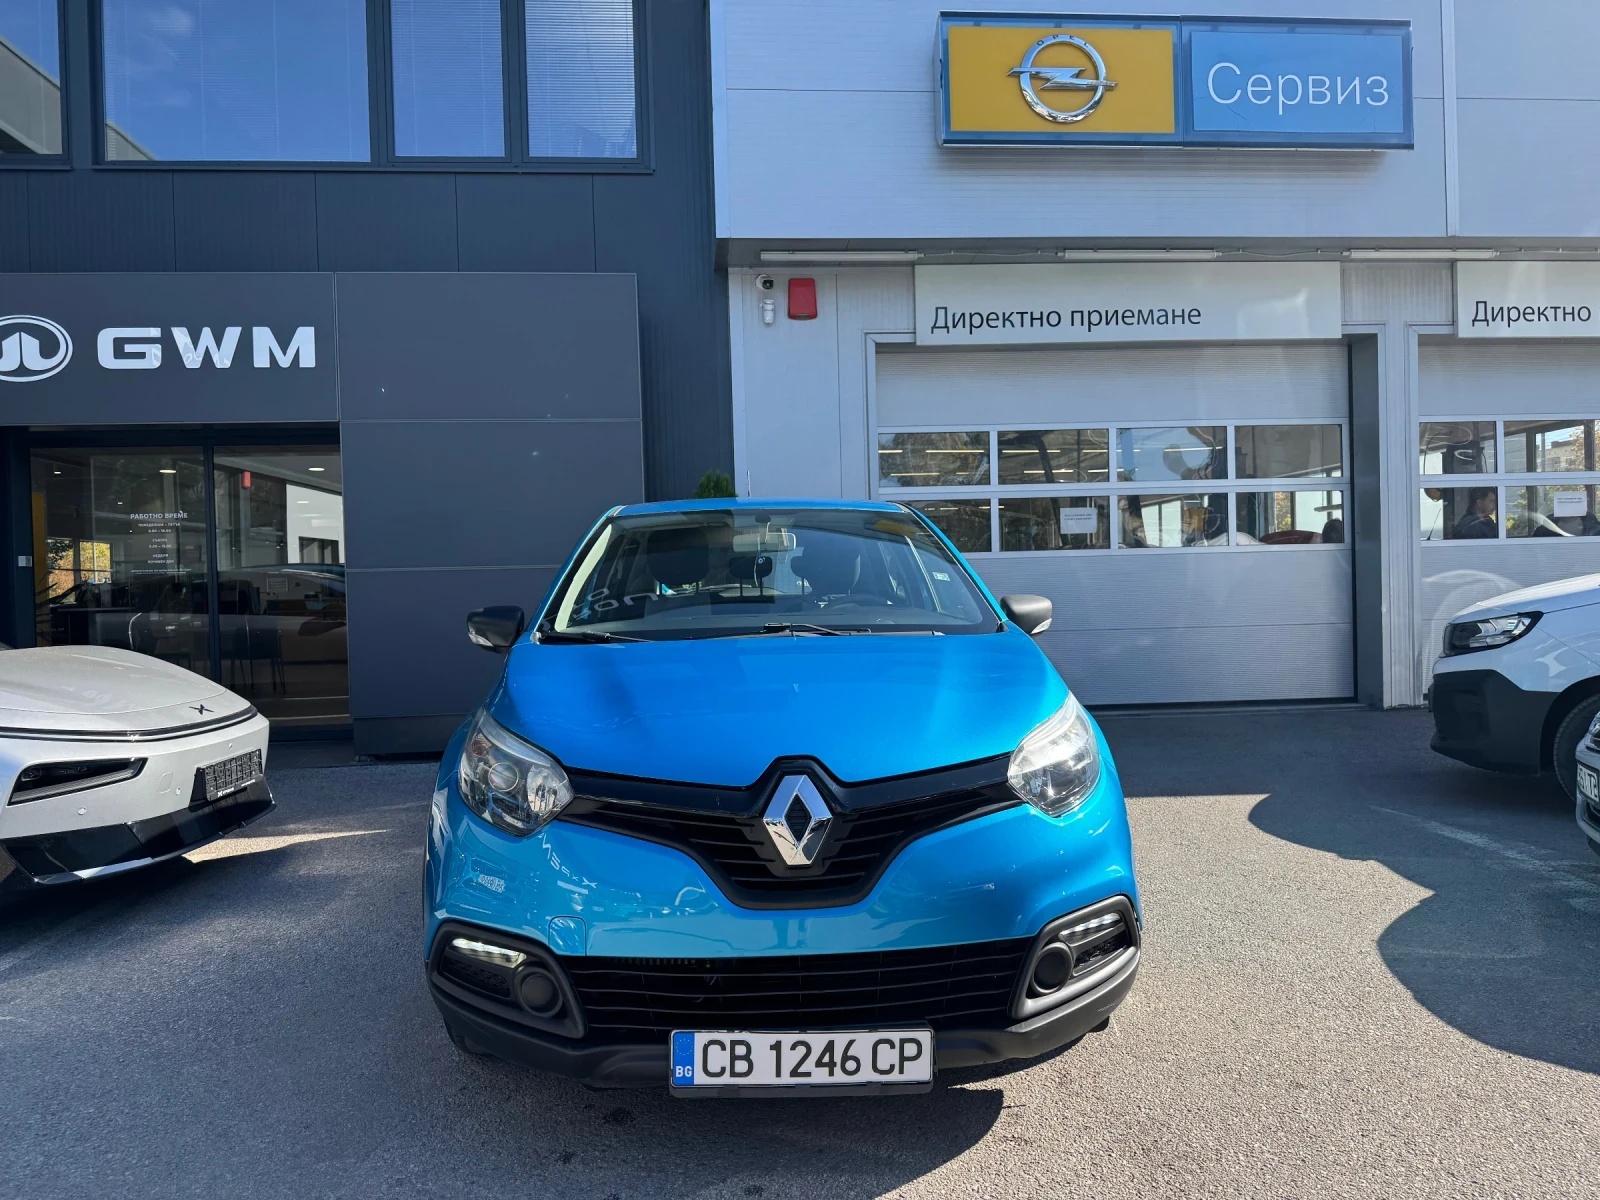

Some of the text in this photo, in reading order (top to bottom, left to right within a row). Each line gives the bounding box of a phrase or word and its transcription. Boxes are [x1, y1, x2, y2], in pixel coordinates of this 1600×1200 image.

[1036, 34, 1089, 48] OPEL
[1207, 61, 1390, 116] Сервиз
[930, 306, 1202, 335] Директно приемане
[1471, 300, 1592, 328] Директно
[97, 325, 317, 370] GWM
[675, 1065, 693, 1078] BG
[702, 1037, 923, 1078] CB 1246 CP
